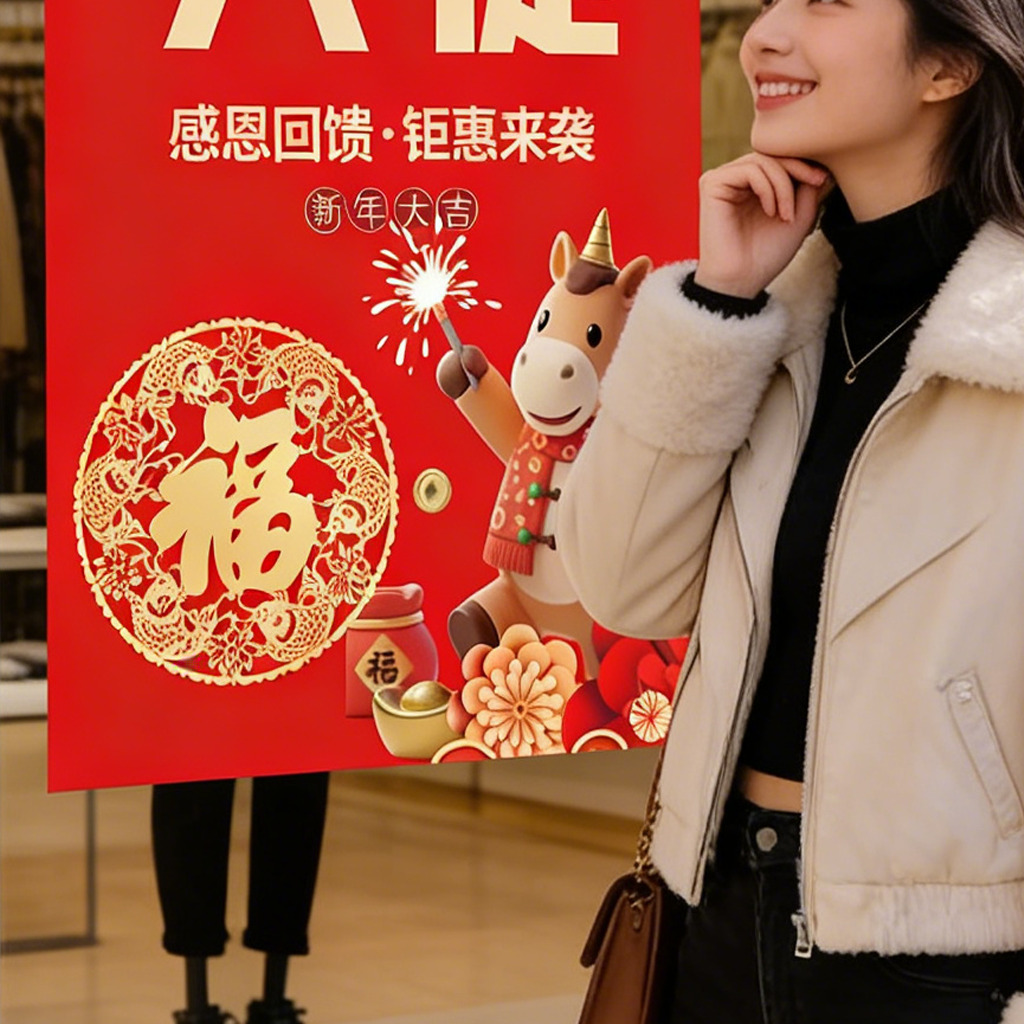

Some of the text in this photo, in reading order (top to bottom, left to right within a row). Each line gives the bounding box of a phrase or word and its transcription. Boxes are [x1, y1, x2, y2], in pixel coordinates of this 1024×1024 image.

[311, 192, 472, 230] 新年大吉
[148, 403, 323, 597] 福
[365, 649, 399, 685] 福
